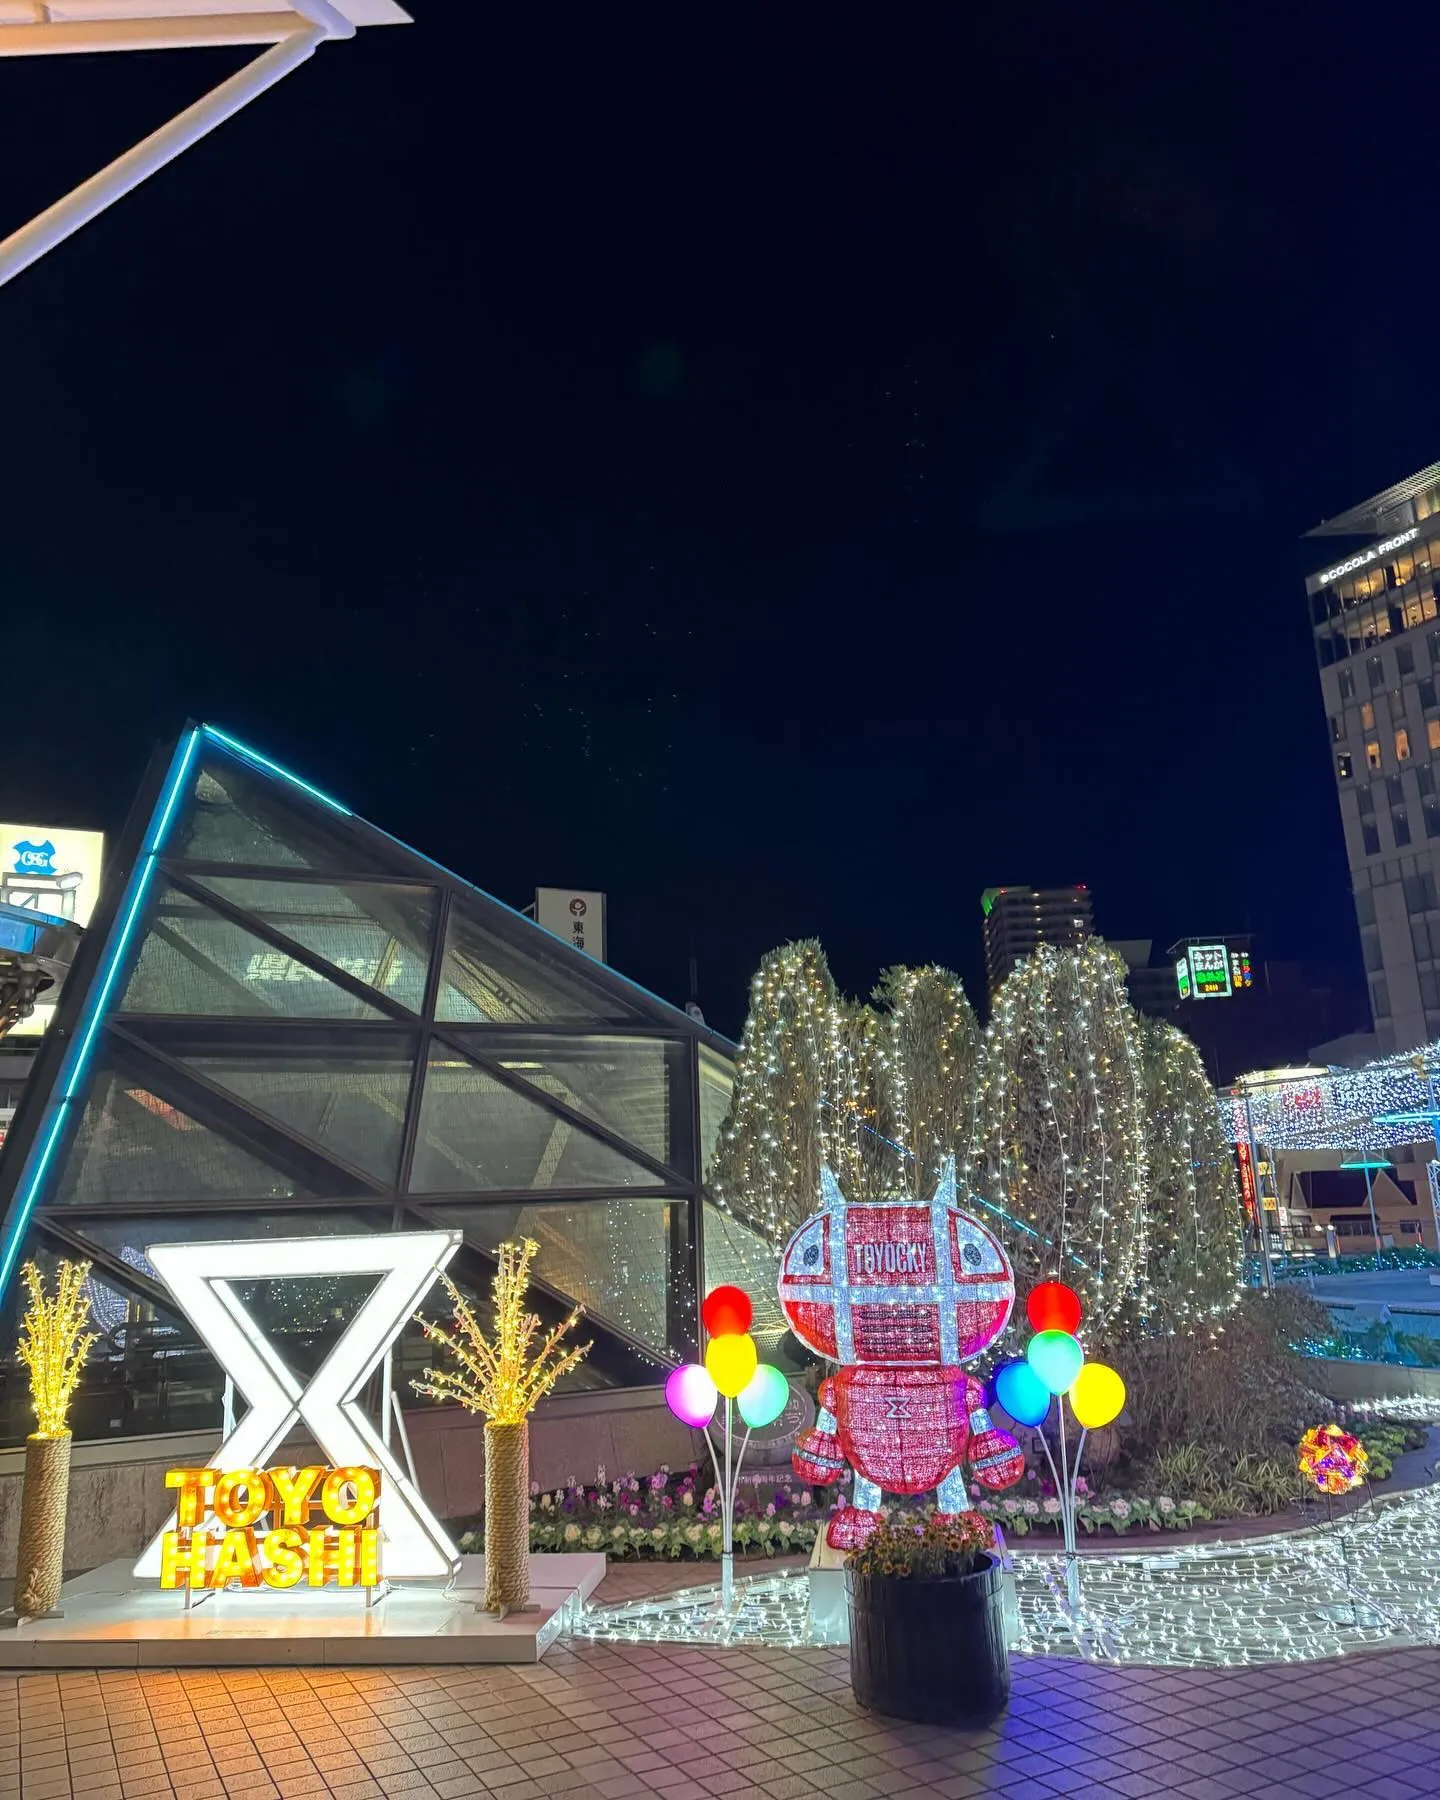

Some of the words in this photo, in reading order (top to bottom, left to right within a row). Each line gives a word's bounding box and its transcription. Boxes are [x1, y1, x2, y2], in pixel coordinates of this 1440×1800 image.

[1328, 551, 1376, 580] COCOLA
[1378, 528, 1419, 555] FRONT
[572, 921, 585, 950] 東海
[1194, 951, 1222, 961] ネット
[1195, 960, 1224, 971] まんが
[853, 1242, 928, 1274] TOYOCKY
[165, 1466, 380, 1527] TOYO
[160, 1528, 380, 1589] HASHI
